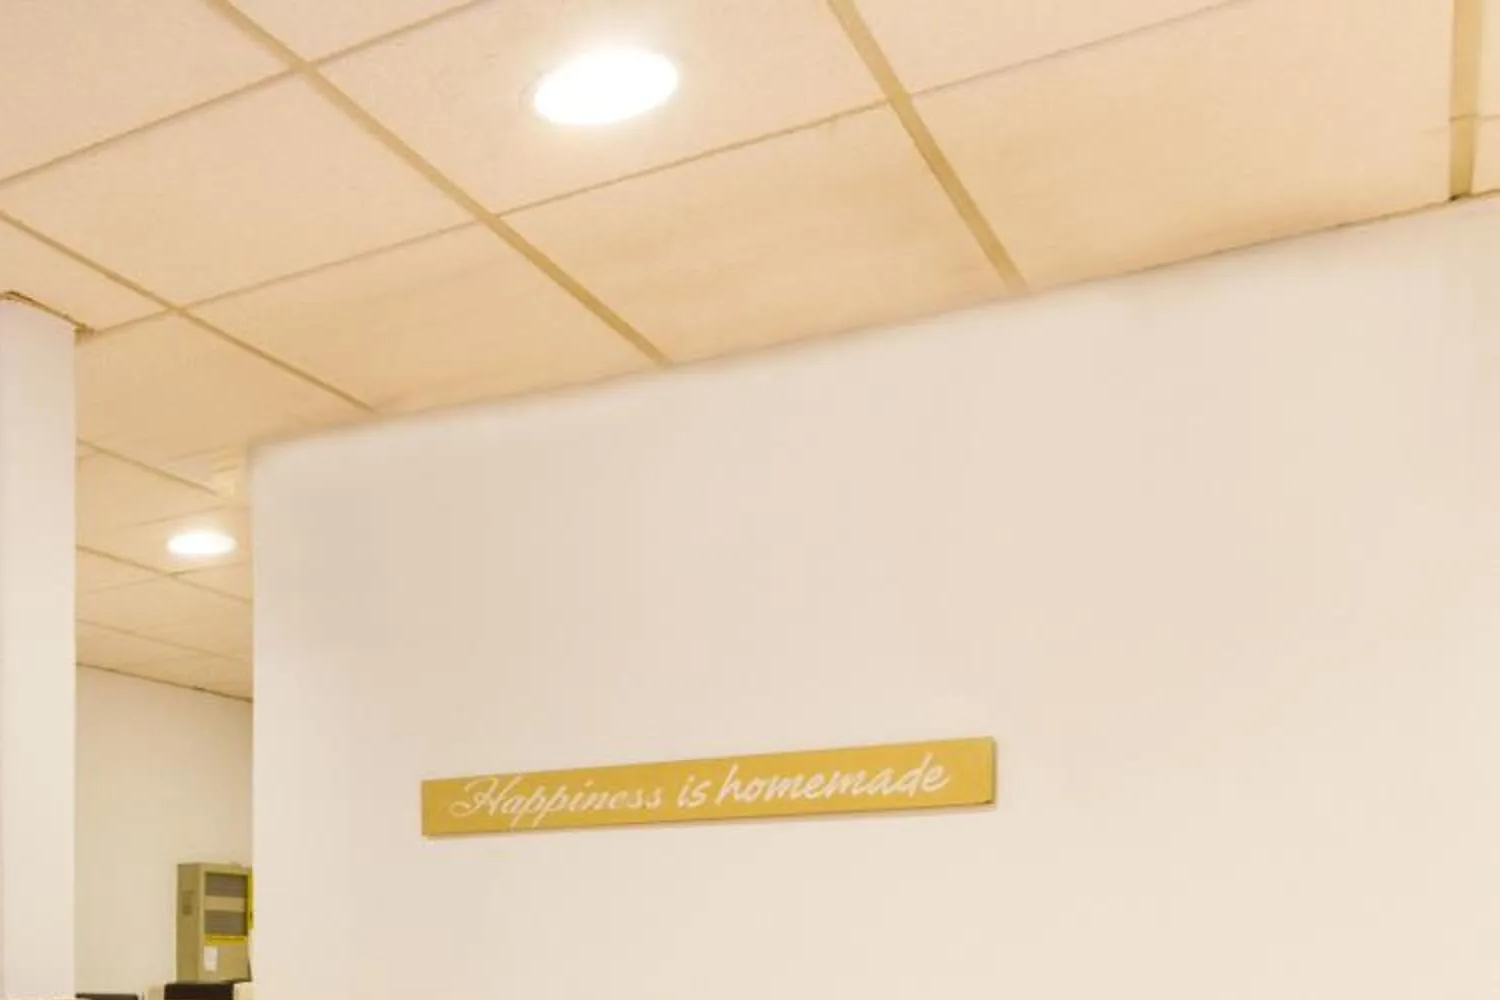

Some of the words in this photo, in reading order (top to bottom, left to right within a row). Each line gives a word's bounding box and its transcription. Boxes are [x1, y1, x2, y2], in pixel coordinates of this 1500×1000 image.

[450, 775, 663, 828] Happiness
[677, 774, 712, 808] is
[715, 752, 949, 806] homemade
